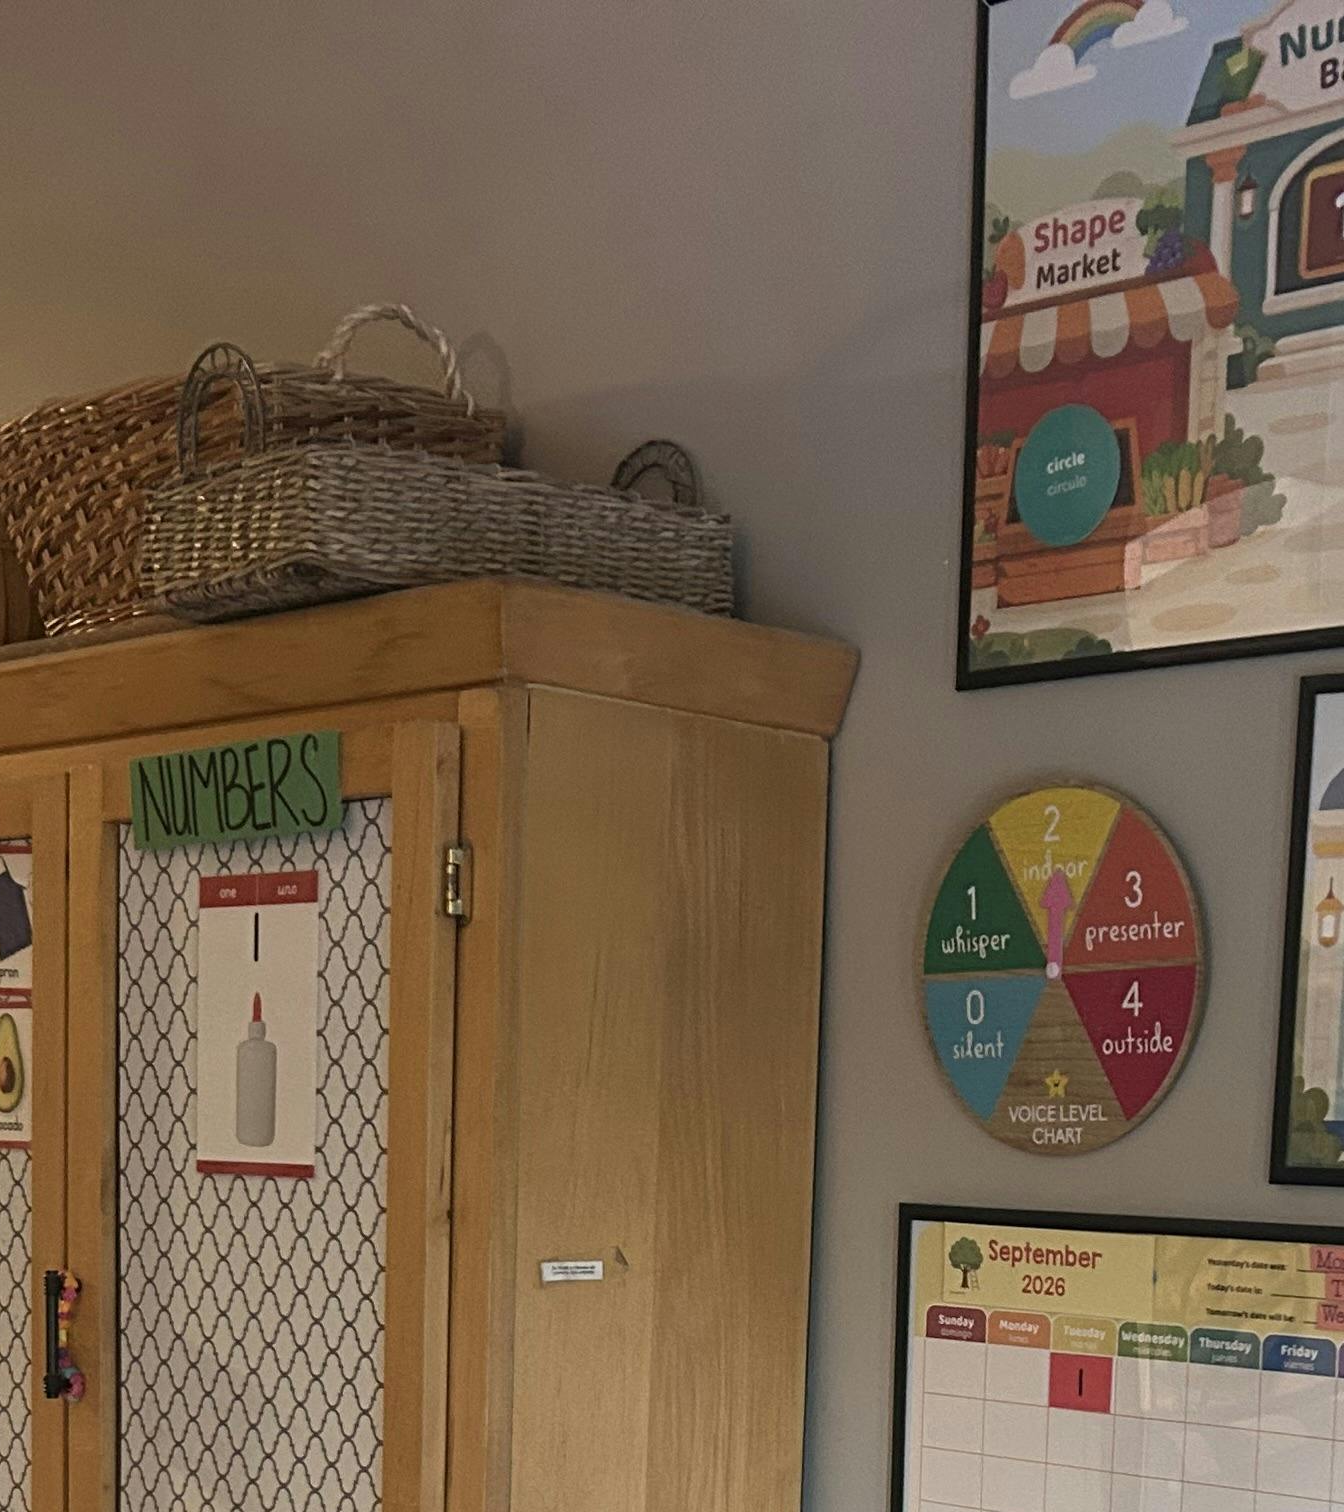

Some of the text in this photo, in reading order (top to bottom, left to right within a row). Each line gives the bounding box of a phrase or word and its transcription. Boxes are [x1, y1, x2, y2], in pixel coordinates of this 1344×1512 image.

[1033, 208, 1126, 253] Shape
[1036, 249, 1122, 289] Market
[1047, 452, 1086, 475] circle
[138, 733, 329, 842] NUMBERS
[1044, 804, 1061, 843] 2
[219, 888, 237, 899] one
[967, 885, 977, 921] 1
[1125, 870, 1143, 908] 3
[941, 925, 1010, 959] whisper
[1085, 911, 1185, 951] presenter
[966, 989, 985, 1025] 0
[1122, 981, 1143, 1017] 4
[953, 1030, 1004, 1060] silent
[1102, 1022, 1173, 1055] outside
[1008, 1104, 1108, 1124] VOICE LEVEL
[1032, 1128, 1083, 1145] CHART
[988, 1238, 1103, 1271] September
[1021, 1274, 1066, 1297] 2026
[938, 1313, 974, 1329] Sunday
[999, 1319, 1039, 1334] Monday
[1064, 1325, 1106, 1340] Tuesday
[1121, 1329, 1185, 1348] Wednesday
[1198, 1336, 1252, 1355] Thursday
[1281, 1344, 1319, 1362] Friday
